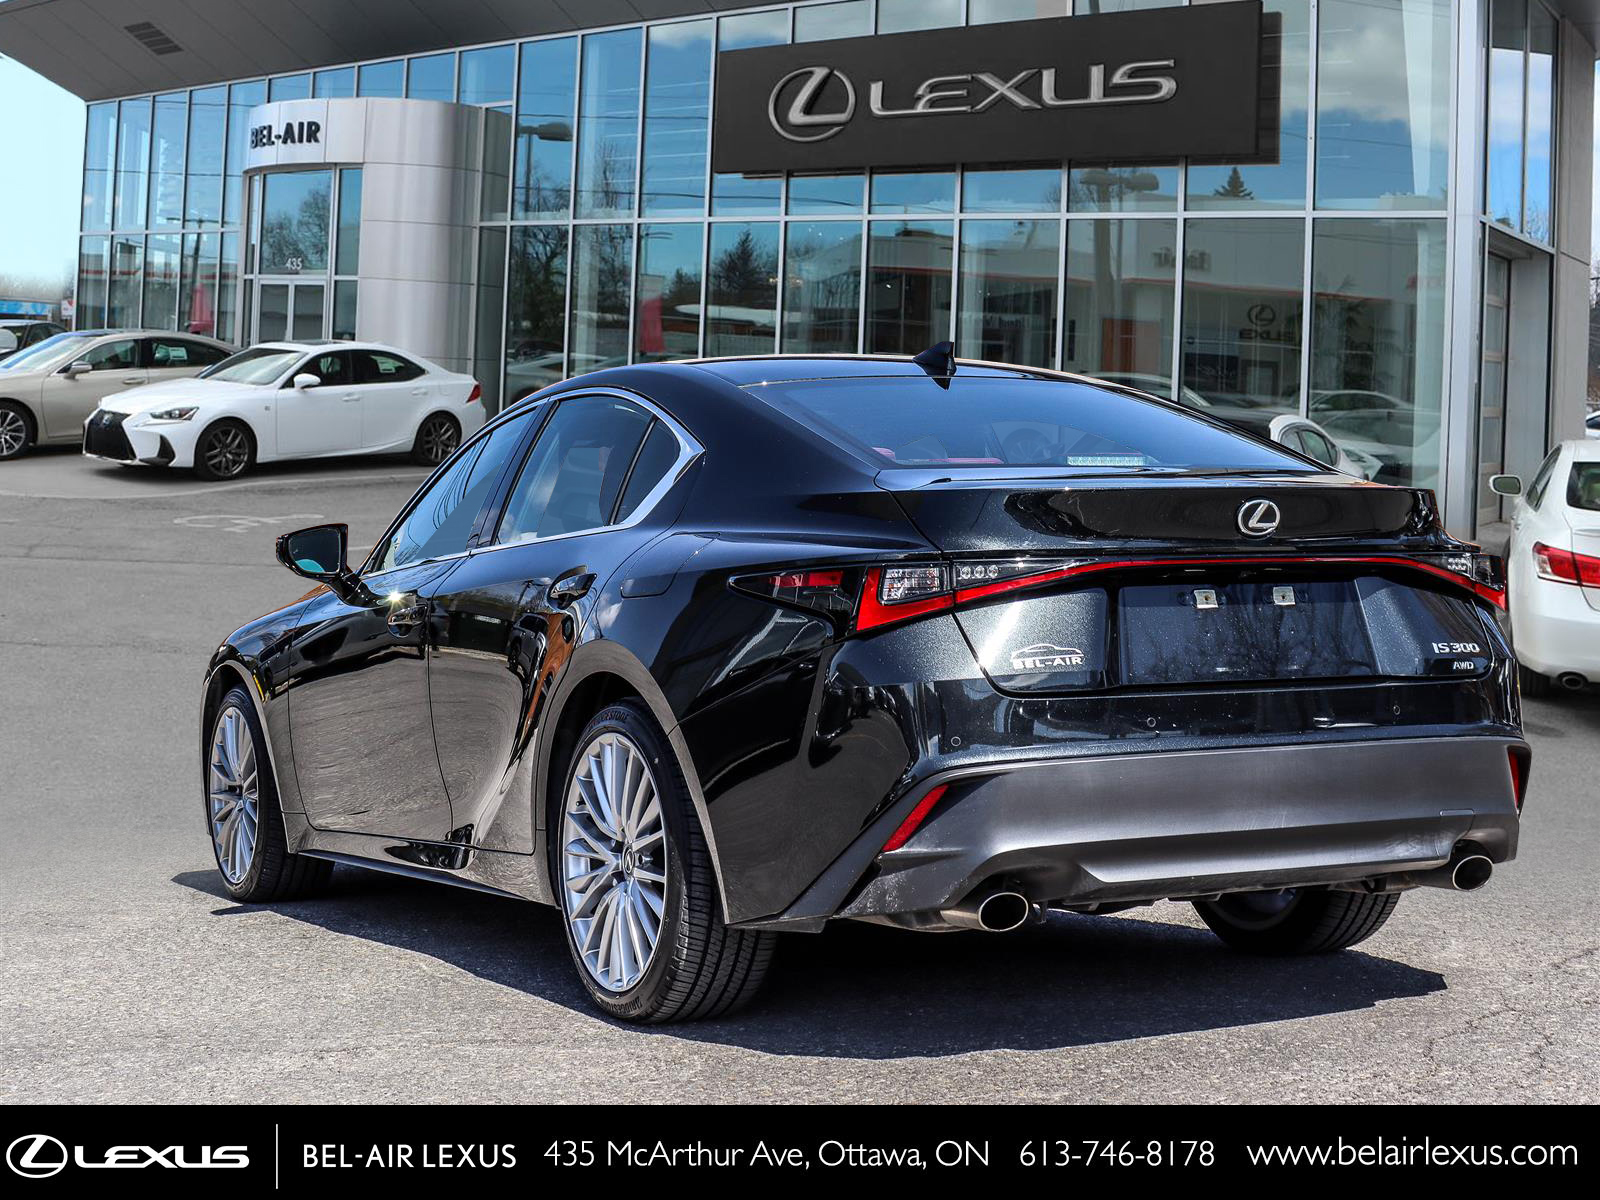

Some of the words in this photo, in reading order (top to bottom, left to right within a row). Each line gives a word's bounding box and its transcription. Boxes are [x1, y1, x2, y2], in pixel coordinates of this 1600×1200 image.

[869, 58, 1178, 119] LEXUS
[250, 121, 321, 149] BEL-AIR
[285, 258, 303, 270] 435
[1432, 642, 1450, 654] IS
[1450, 642, 1480, 653] 300
[1012, 656, 1083, 670] BEL-AIR
[1452, 661, 1475, 670] AWD
